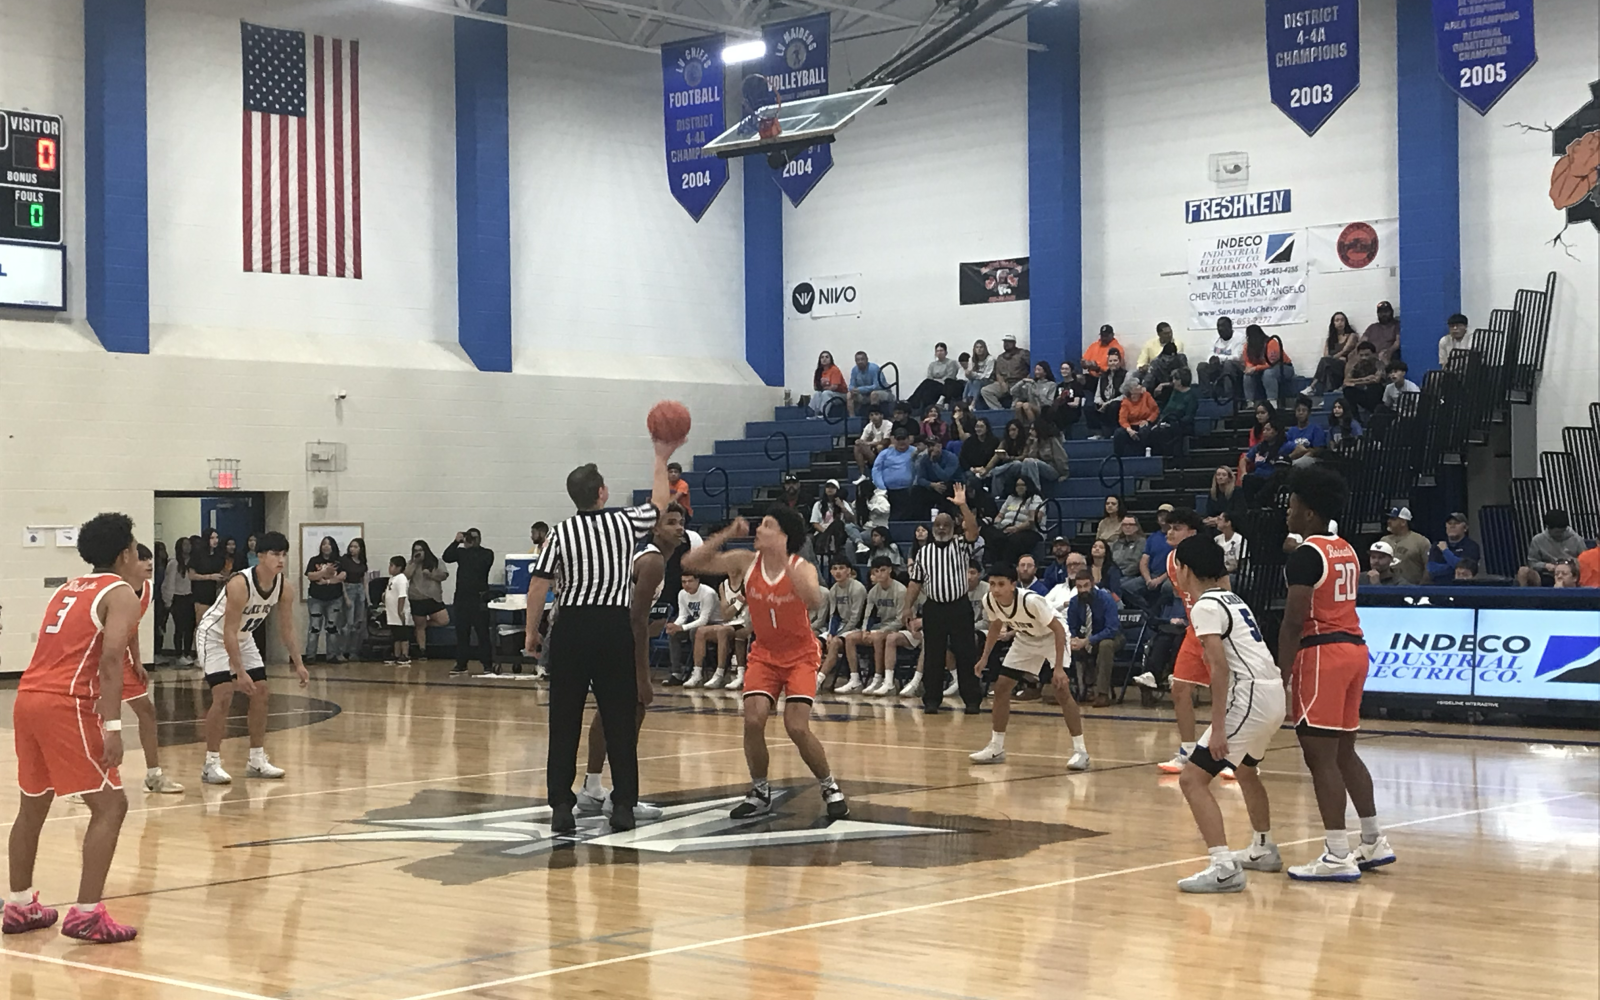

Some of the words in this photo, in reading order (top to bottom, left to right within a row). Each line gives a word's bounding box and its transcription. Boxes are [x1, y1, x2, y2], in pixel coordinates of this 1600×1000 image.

[1284, 5, 1339, 29] DISTRICT
[783, 26, 817, 51] MAIDENS
[1296, 26, 1326, 45] 4-4A
[685, 46, 712, 69] CHIEFS
[1275, 42, 1347, 68] CHAMPIONS
[766, 66, 827, 92] VOLLEYBALL
[1460, 61, 1507, 88] 2005
[669, 86, 720, 108] FOOTBALL
[1290, 83, 1333, 108] 2003
[10, 115, 59, 135] VISITOR
[676, 113, 714, 131] DISTRICT
[37, 137, 56, 171] 0
[7, 170, 38, 184] BONUS
[782, 157, 813, 178] 2004
[681, 170, 711, 189] 2004
[15, 190, 44, 203] FOULS
[1188, 190, 1285, 223] FRESHMEN
[30, 203, 43, 227] 0
[1202, 247, 1260, 259] INDUSTRIAL
[1216, 235, 1263, 250] INDECO
[1198, 262, 1259, 274] AUTOMATION
[1200, 257, 1244, 266] ELECTRIC
[819, 286, 856, 305] NIVO
[1189, 289, 1238, 302] CHEVROLET
[1240, 289, 1248, 298] of
[1250, 287, 1268, 297] SAN
[1271, 284, 1306, 294] ANGELO
[1212, 282, 1229, 292] ALL
[1198, 304, 1297, 317] www.SanAngeloChevy.com
[1334, 562, 1357, 602] 20
[45, 595, 77, 634] 3
[769, 607, 778, 629] 1
[1238, 608, 1262, 643] 5
[1390, 633, 1531, 654] INDECO
[1368, 650, 1523, 670] NDUSTRIAL
[1479, 669, 1522, 683] CO.
